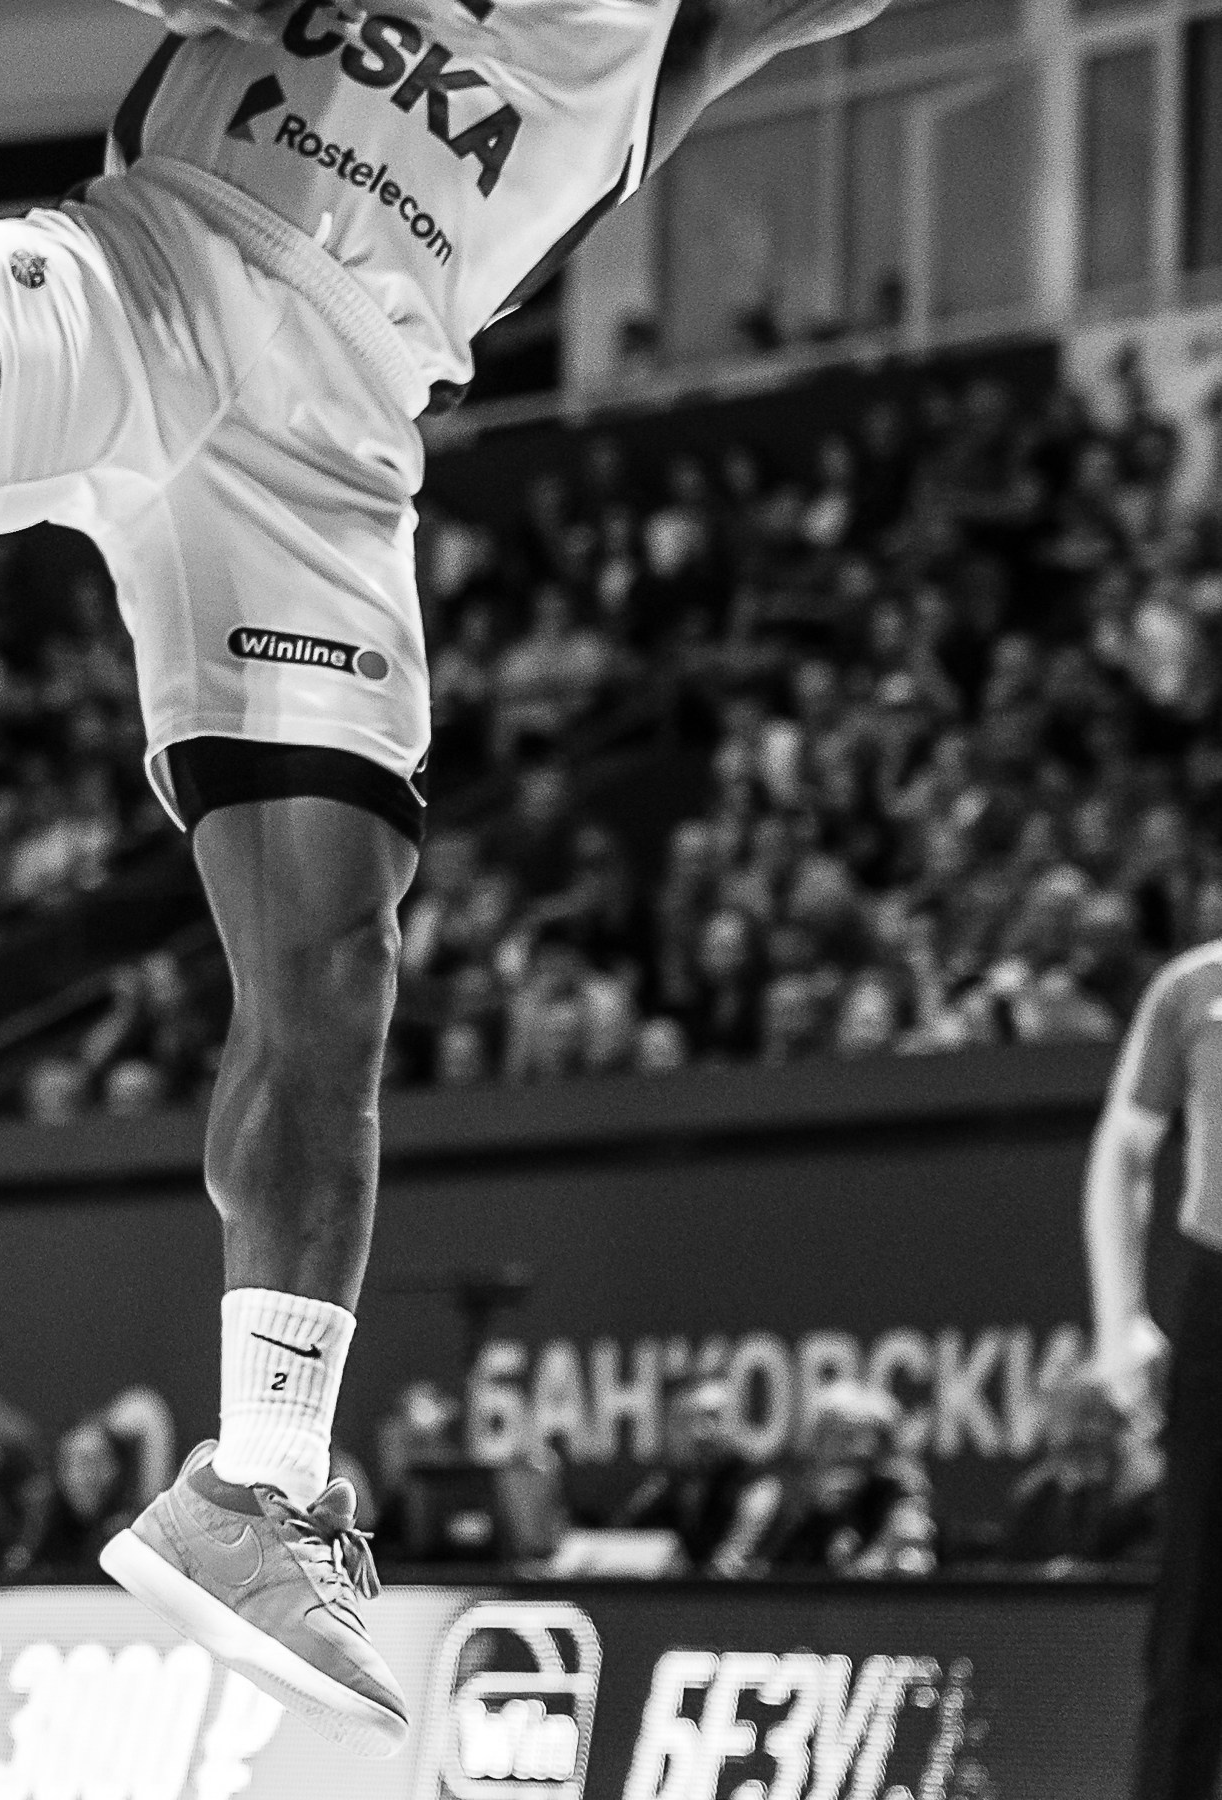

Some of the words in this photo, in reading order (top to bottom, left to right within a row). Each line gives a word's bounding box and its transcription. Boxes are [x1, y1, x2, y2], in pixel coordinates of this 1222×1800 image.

[274, 113, 454, 267] Rostelecom
[240, 631, 348, 667] Winline
[270, 1371, 290, 1391] 2
